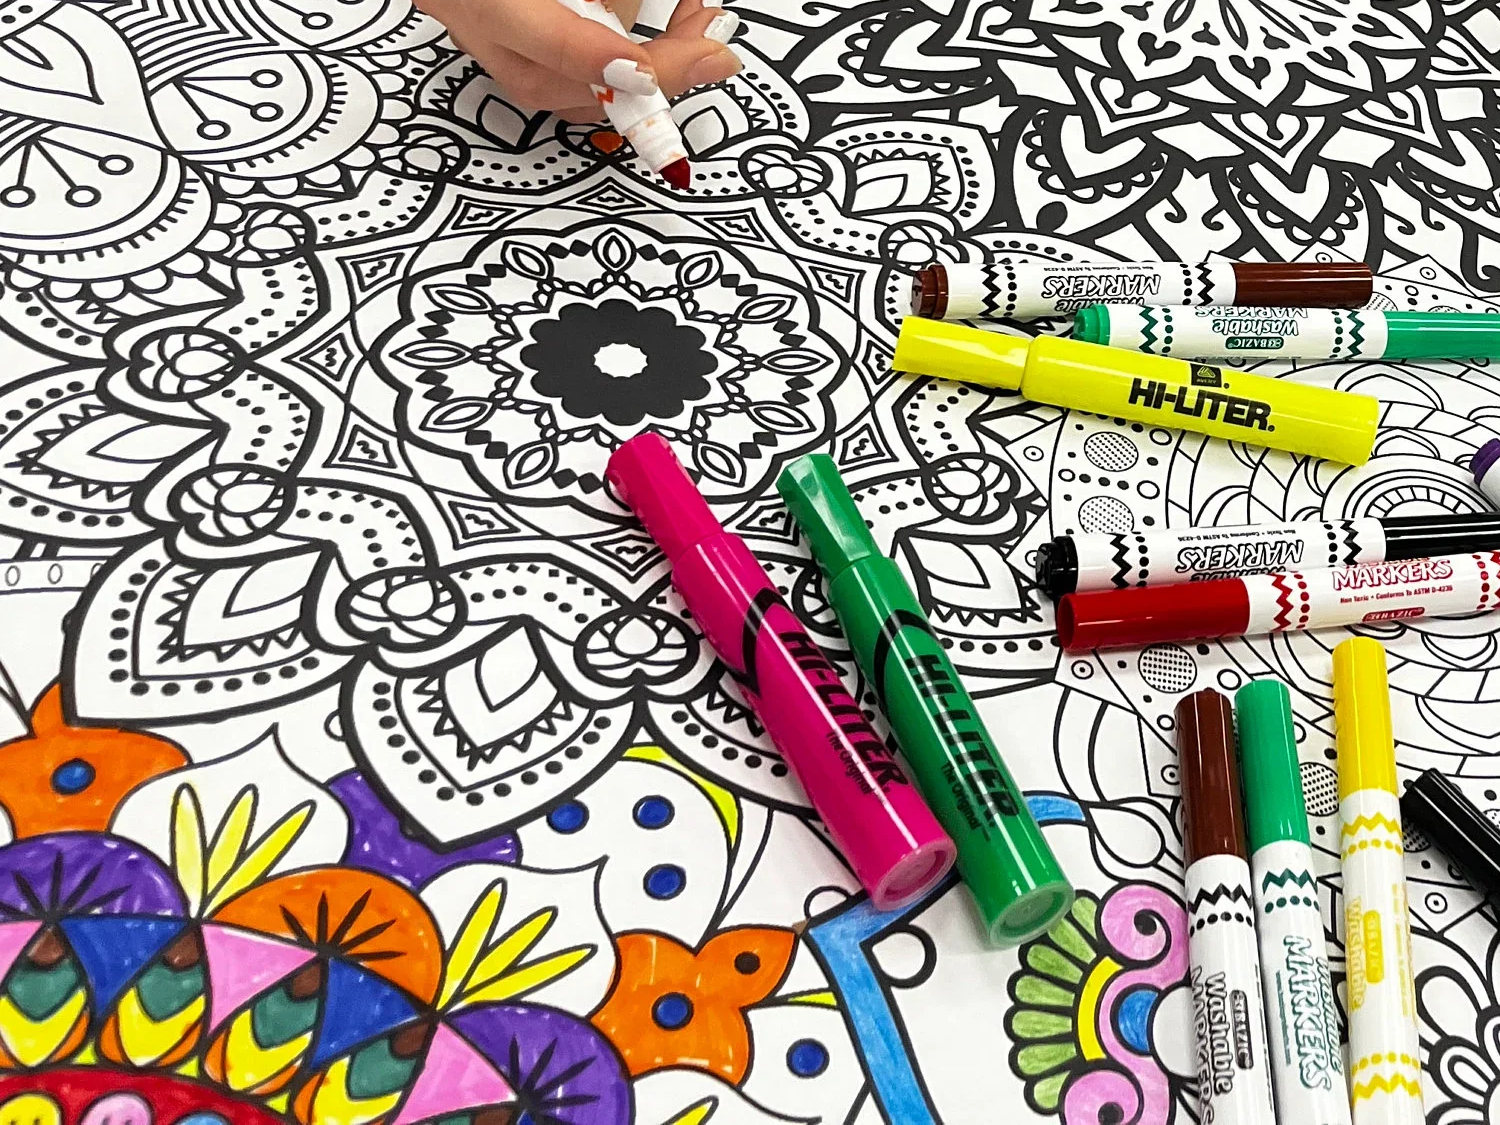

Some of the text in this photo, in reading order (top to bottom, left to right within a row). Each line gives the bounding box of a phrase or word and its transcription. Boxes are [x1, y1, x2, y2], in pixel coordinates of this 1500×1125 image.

[1040, 274, 1162, 298] MARKERS
[1211, 318, 1298, 336] Washable
[1233, 338, 1267, 348] BAZIC
[1127, 376, 1272, 431] HI-LITER
[1173, 538, 1305, 573] MARKERS
[1331, 558, 1454, 591] MARKERS
[1375, 590, 1404, 599] Conforms
[1413, 586, 1430, 595] ASTM
[903, 651, 1020, 822] HI-LITER
[824, 729, 875, 797] The Original
[939, 760, 983, 831] The Original
[1204, 971, 1236, 1096] Washable
[1282, 932, 1332, 1091] MARKERS
